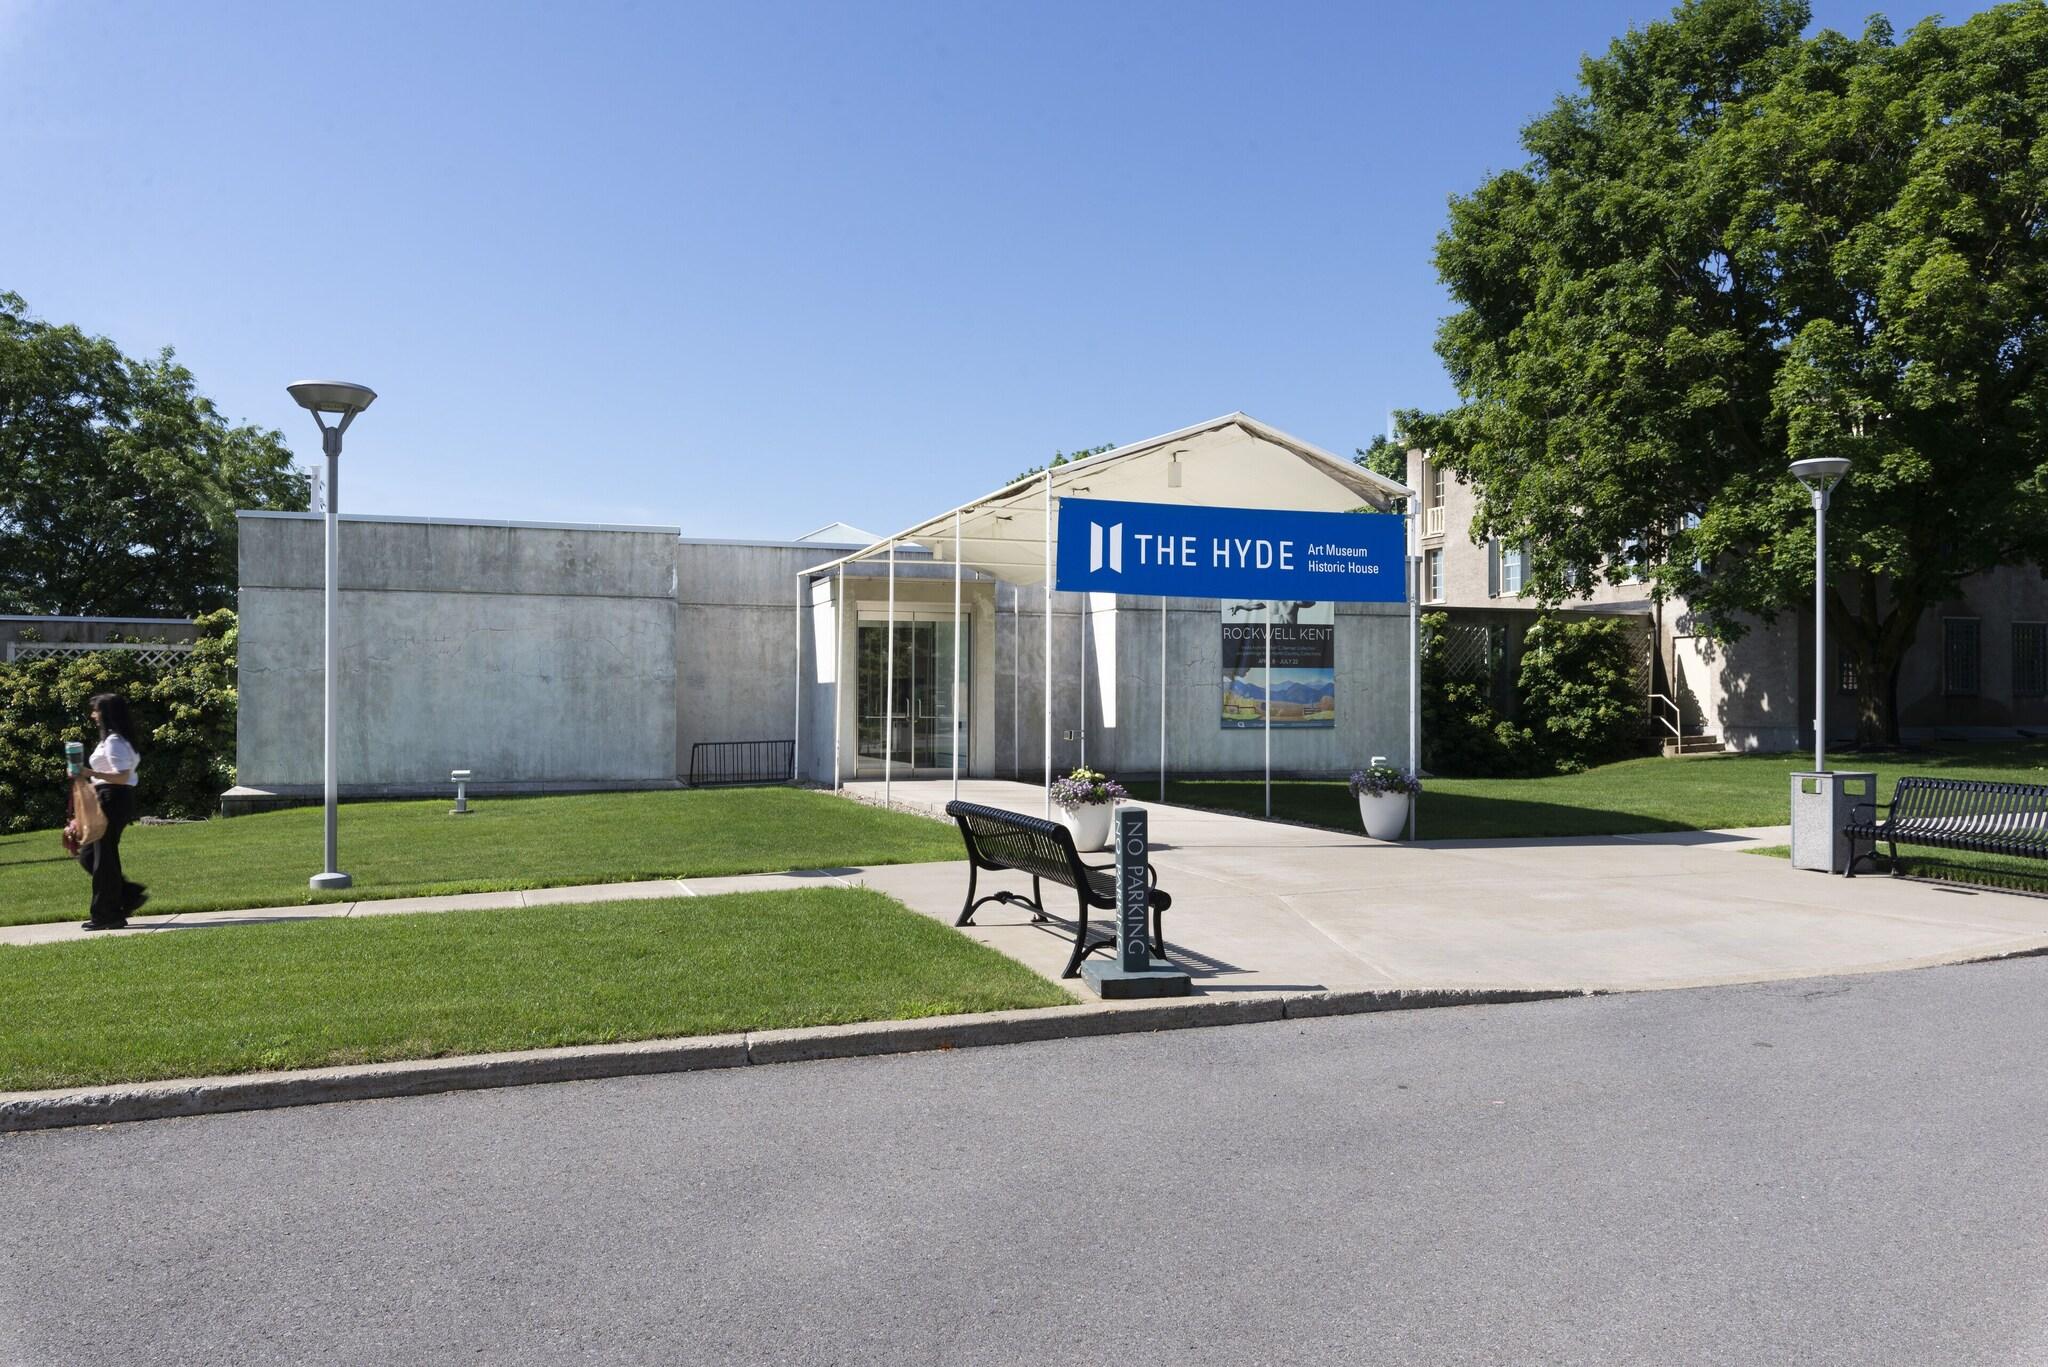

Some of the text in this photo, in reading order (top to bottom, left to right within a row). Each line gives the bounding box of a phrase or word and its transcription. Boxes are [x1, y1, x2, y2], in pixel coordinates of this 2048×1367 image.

[1134, 534, 1294, 570] THE HYDE
[1308, 544, 1368, 557] Art Museum
[1308, 560, 1379, 574] Historic House
[1223, 627, 1333, 641] ROCKWELL KENT
[1115, 820, 1121, 855] NO
[1127, 822, 1145, 955] NO PARKING
